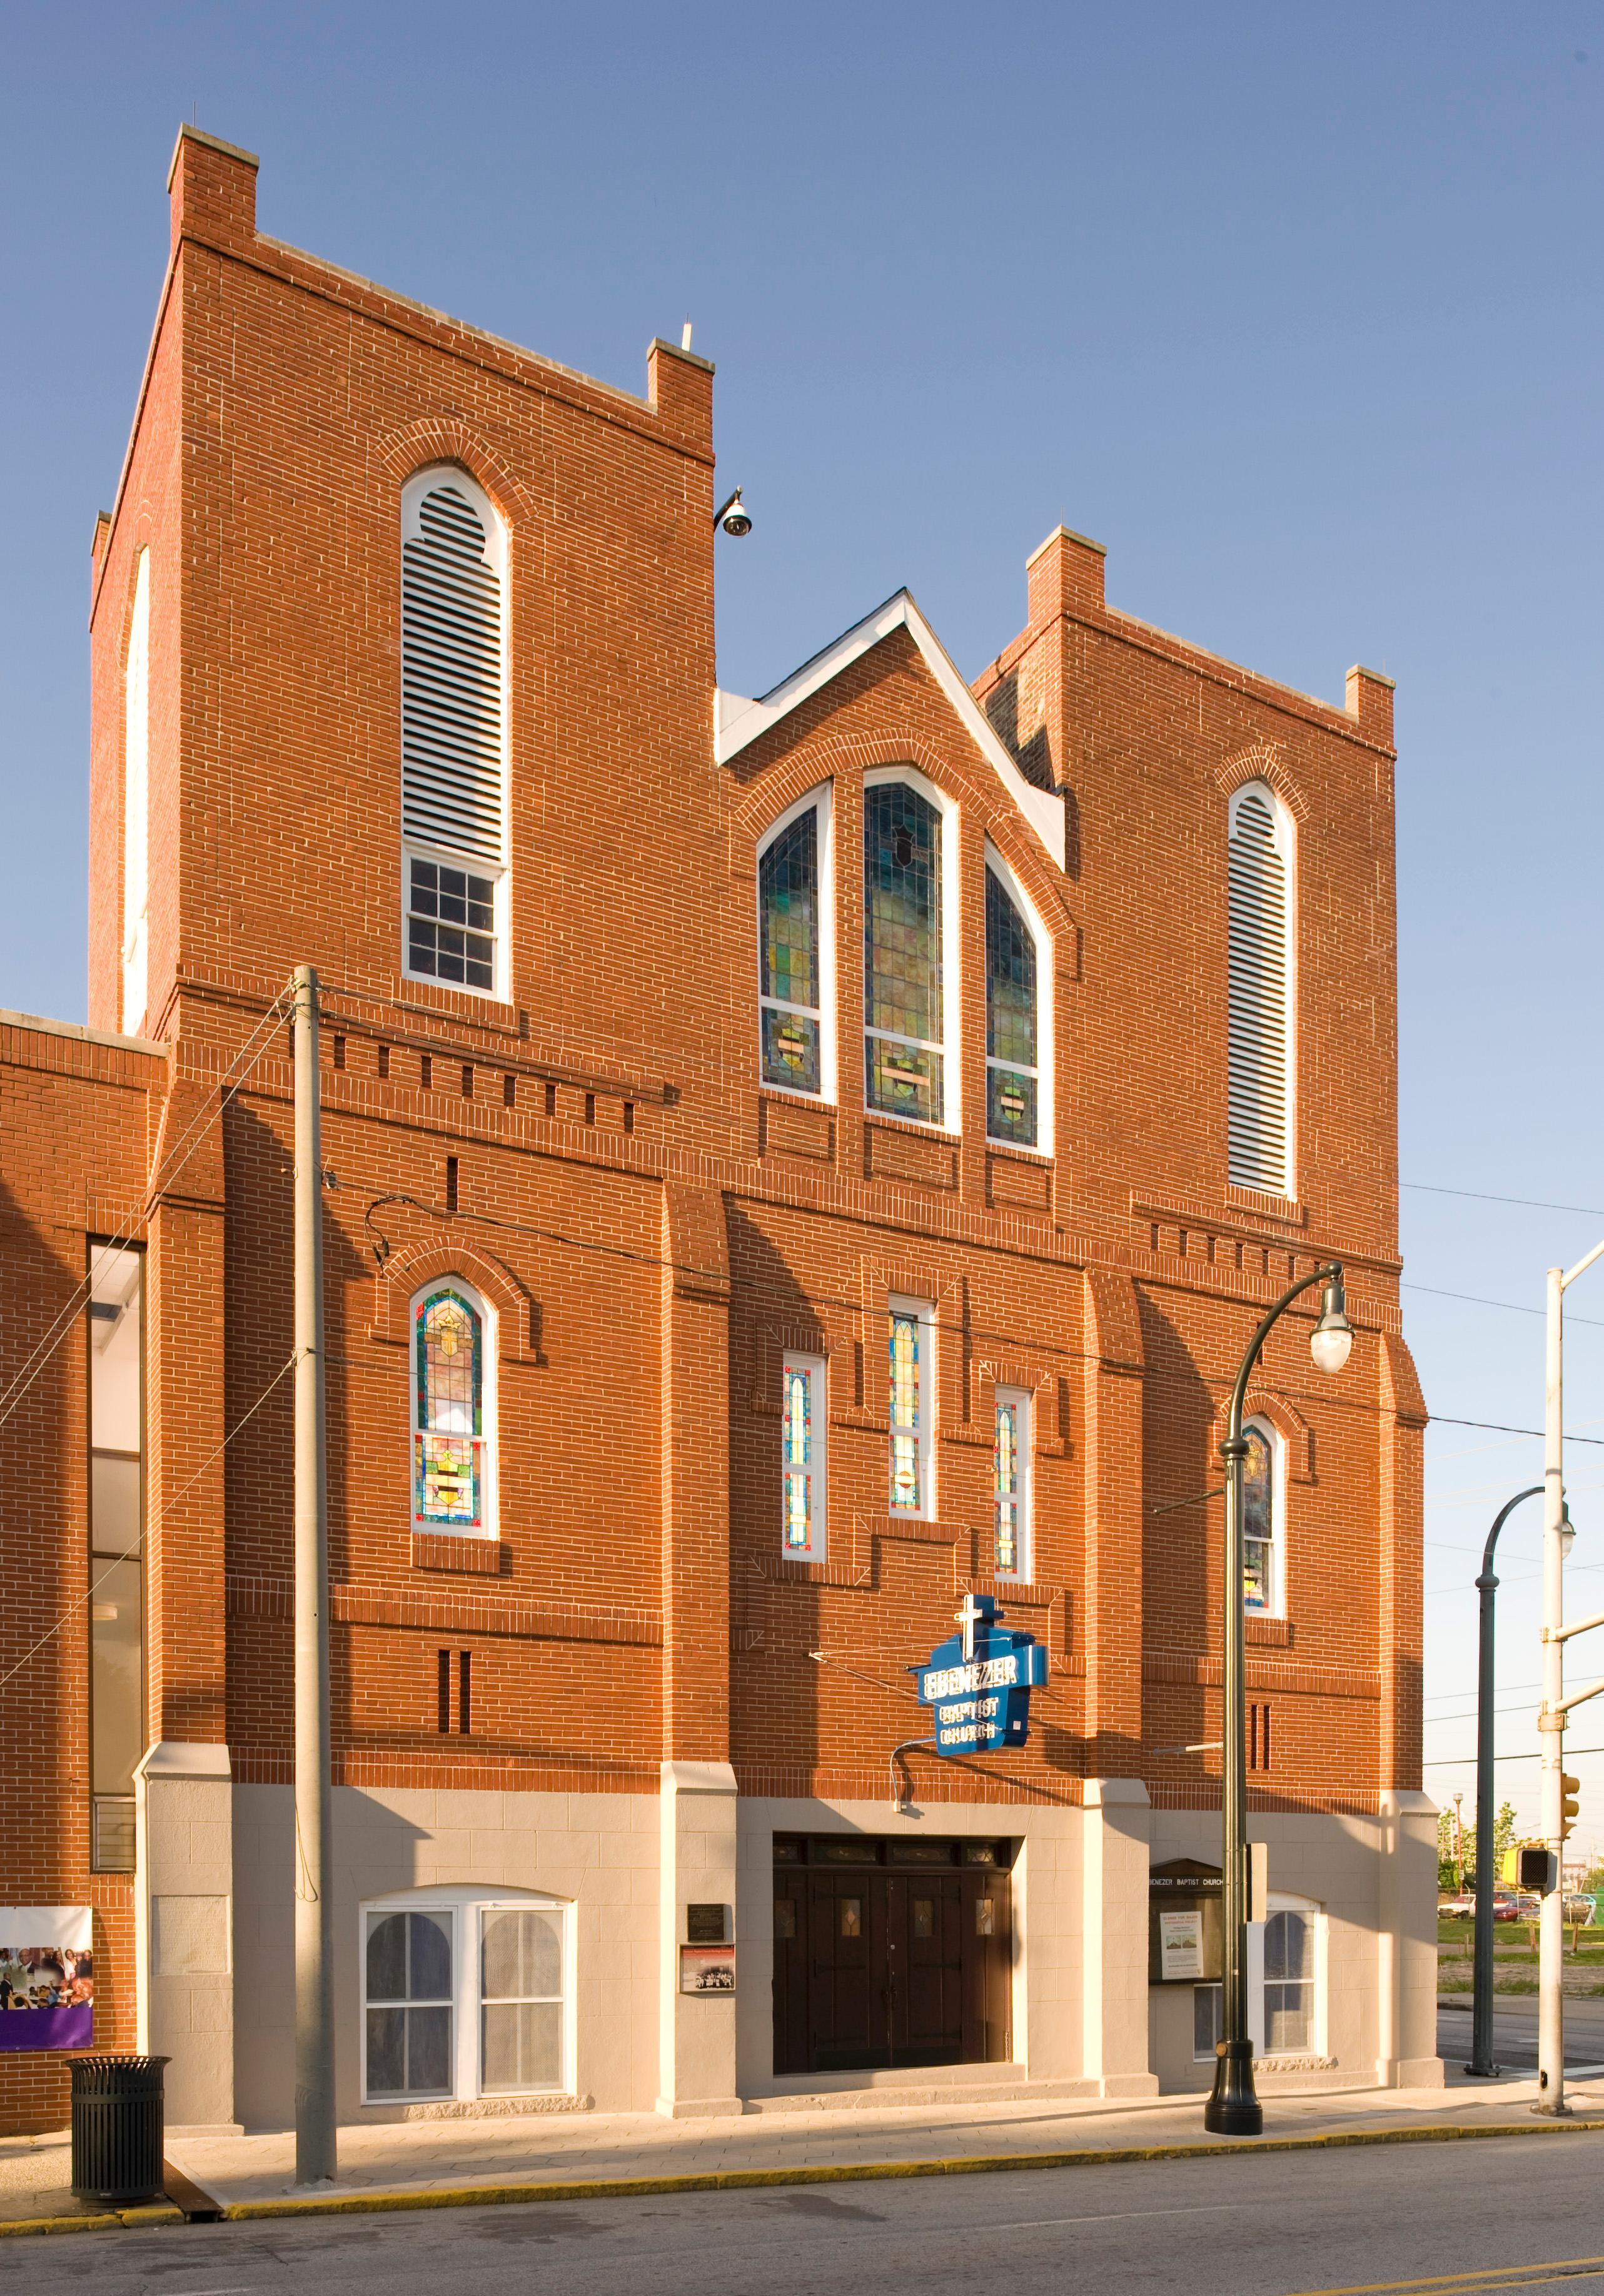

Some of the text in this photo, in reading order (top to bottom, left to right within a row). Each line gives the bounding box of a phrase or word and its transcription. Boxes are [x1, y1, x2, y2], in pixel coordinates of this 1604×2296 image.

[924, 1656, 1017, 1700] EBENEZER
[939, 1697, 999, 1724] BAPTIST
[940, 1721, 996, 1745] CHURCH
